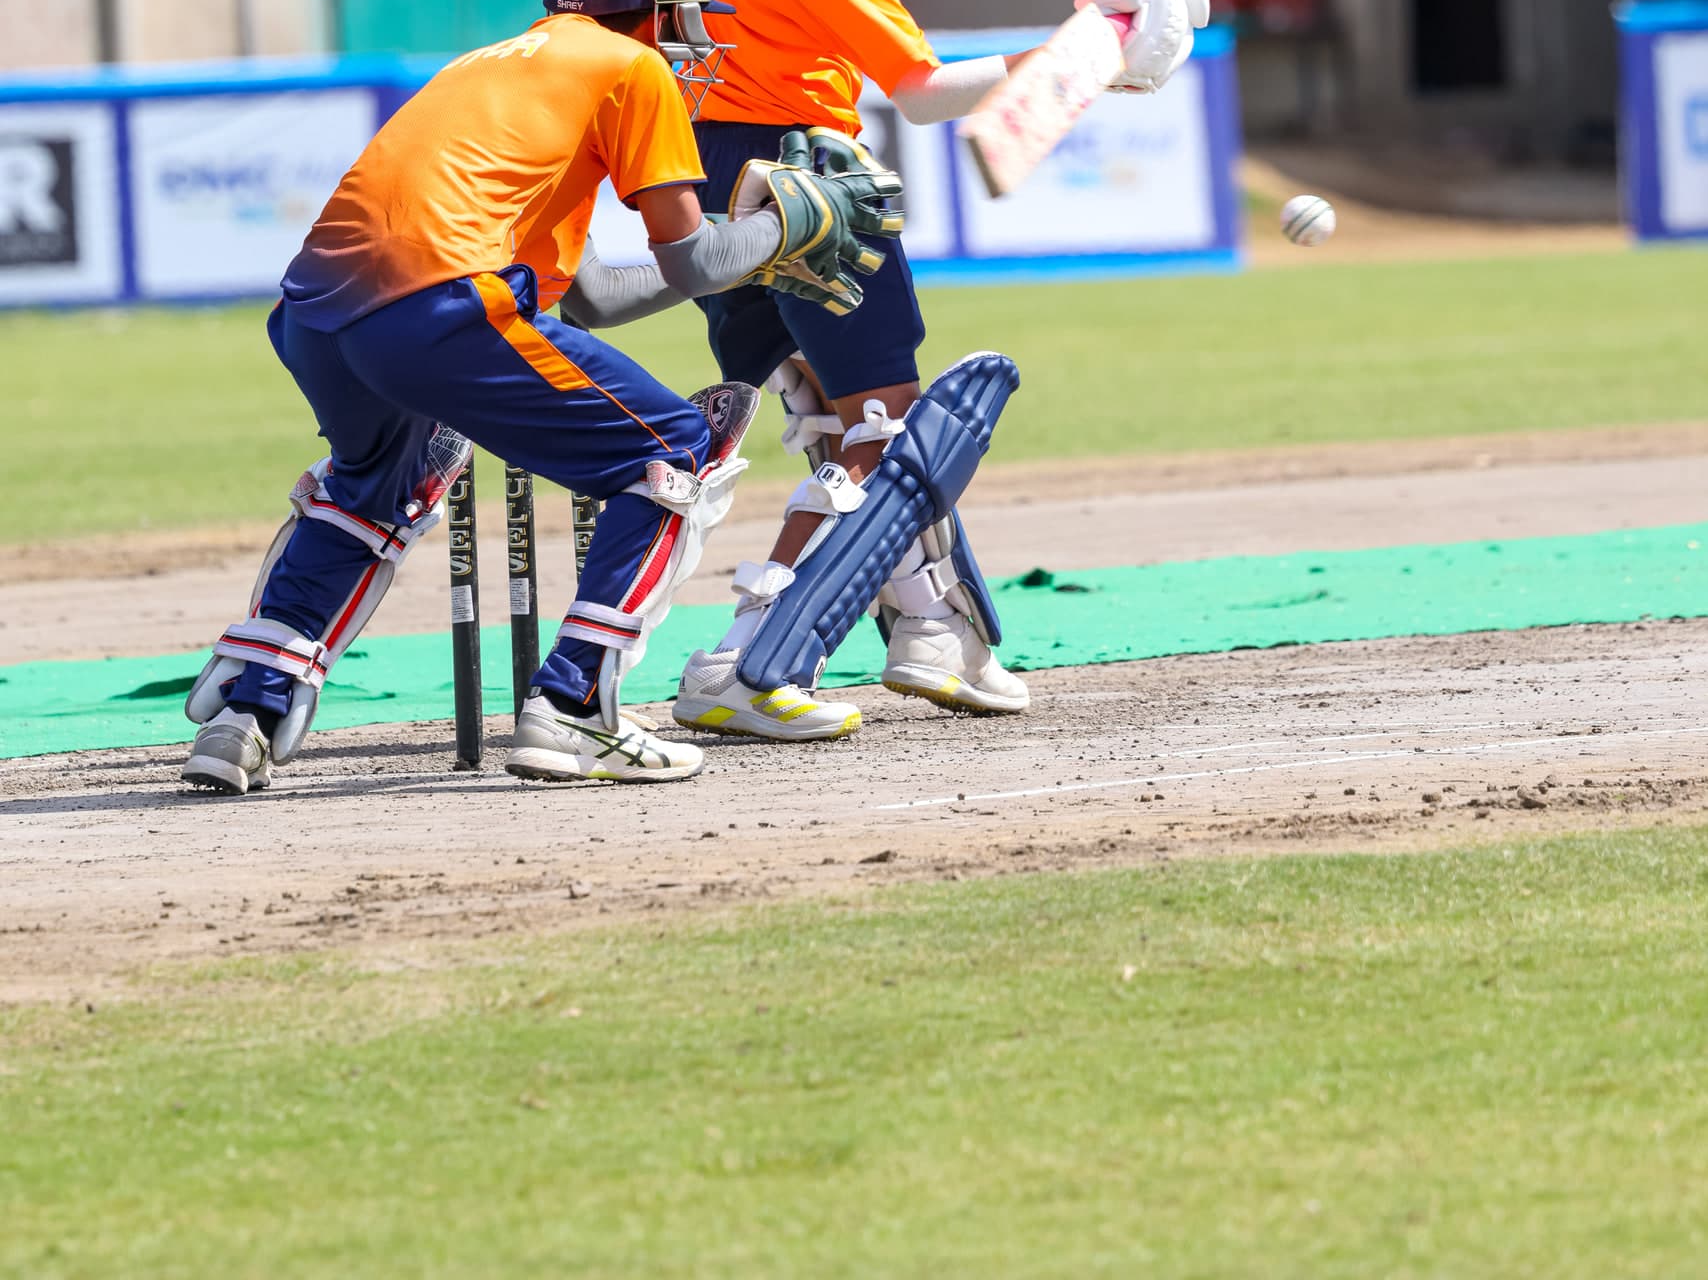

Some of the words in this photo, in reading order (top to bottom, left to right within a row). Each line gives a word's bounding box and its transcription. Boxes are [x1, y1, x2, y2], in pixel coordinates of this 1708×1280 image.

[557, 0, 584, 11] SHREY
[448, 468, 472, 576] ULES
[505, 467, 528, 573] ULES
